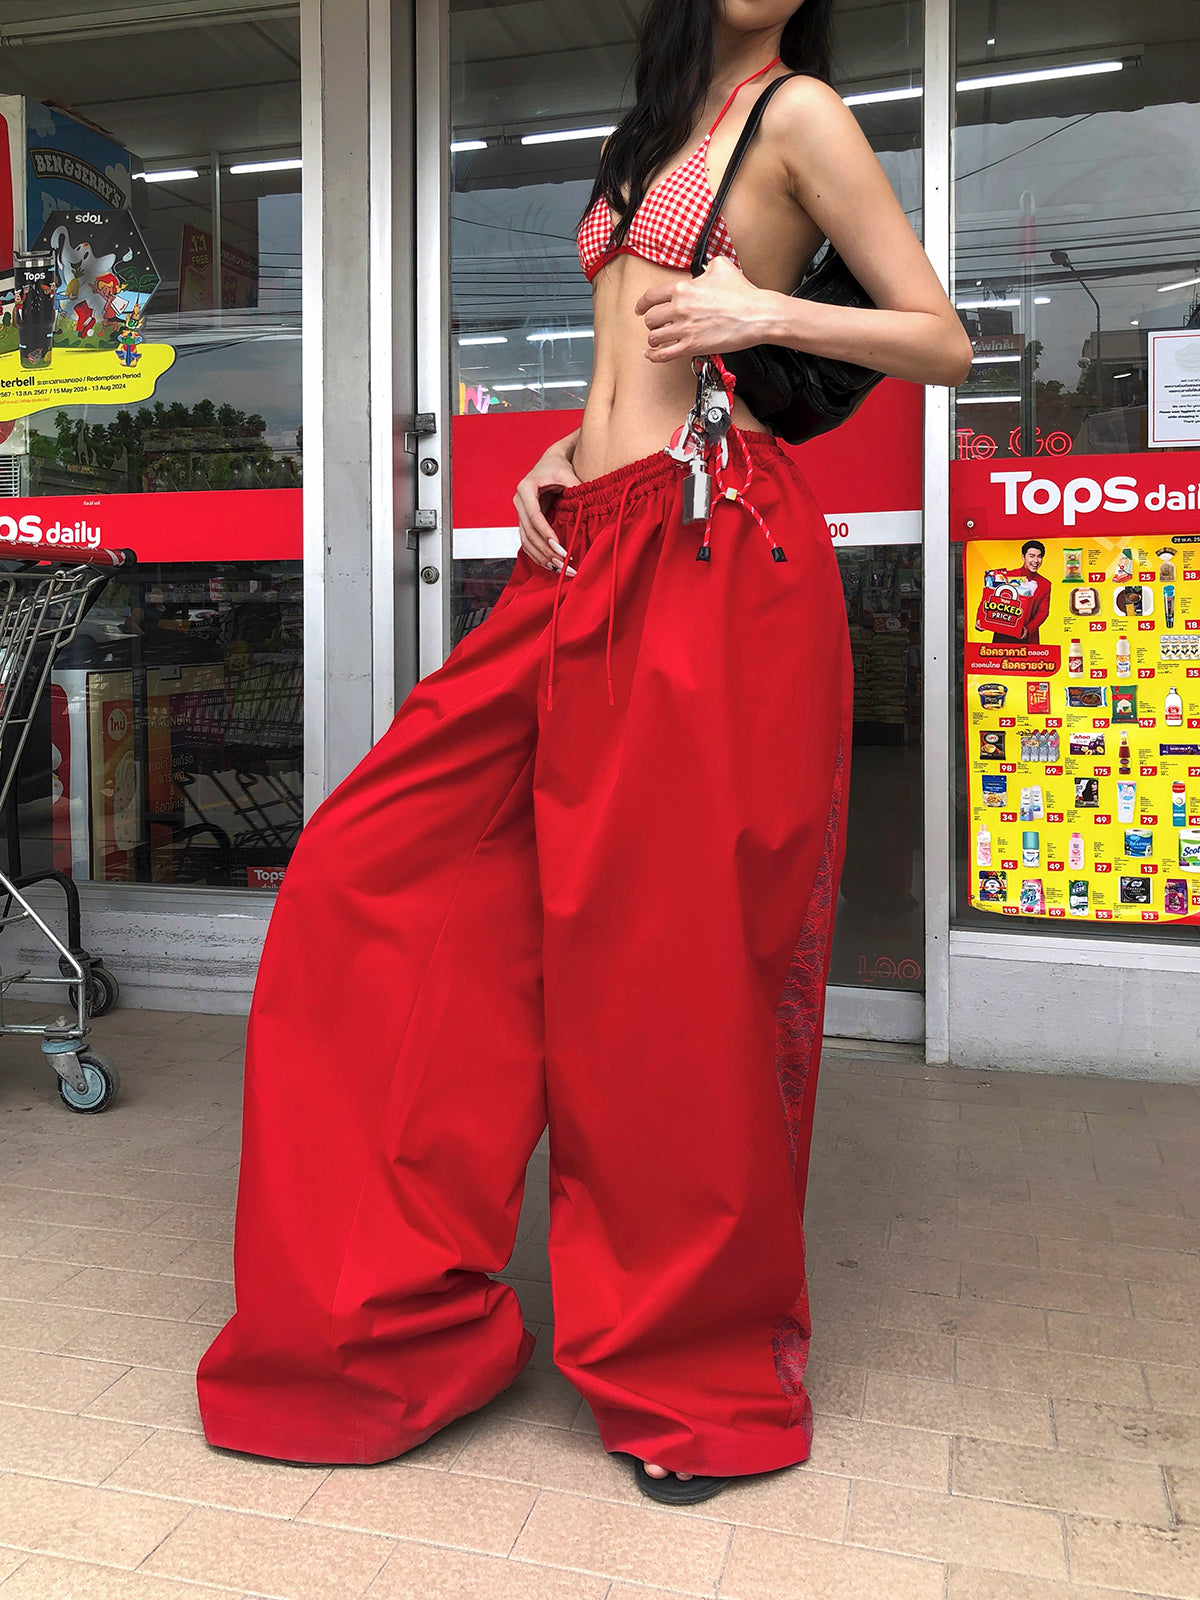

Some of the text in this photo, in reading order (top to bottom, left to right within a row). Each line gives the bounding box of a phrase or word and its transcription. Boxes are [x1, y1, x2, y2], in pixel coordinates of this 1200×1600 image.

[75, 212, 103, 224] Tops
[192, 254, 209, 265] FREE
[24, 271, 46, 282] Tops
[86, 374, 121, 382] Redemption
[711, 410, 718, 420] 8
[956, 428, 996, 461] To
[990, 471, 1139, 526] Tops
[46, 520, 101, 549] daily
[1185, 571, 1197, 579] 38
[984, 602, 1023, 616] LOCKED
[991, 612, 1013, 622] PRICE
[1091, 623, 1102, 631] 26
[1140, 622, 1151, 630] 45
[1187, 621, 1198, 629] 18
[1092, 670, 1103, 678] 23
[1140, 670, 1151, 678] 37
[1188, 669, 1199, 677] 35
[1139, 719, 1154, 727] 147
[1046, 767, 1057, 775] 69
[1094, 768, 1108, 776] 175
[1142, 767, 1153, 775] 27
[1049, 814, 1059, 822] 35
[1142, 816, 1153, 824] 79
[1003, 861, 1014, 869] 45
[1143, 865, 1153, 873] 13
[254, 869, 286, 884] Tops
[1143, 912, 1154, 920] 33
